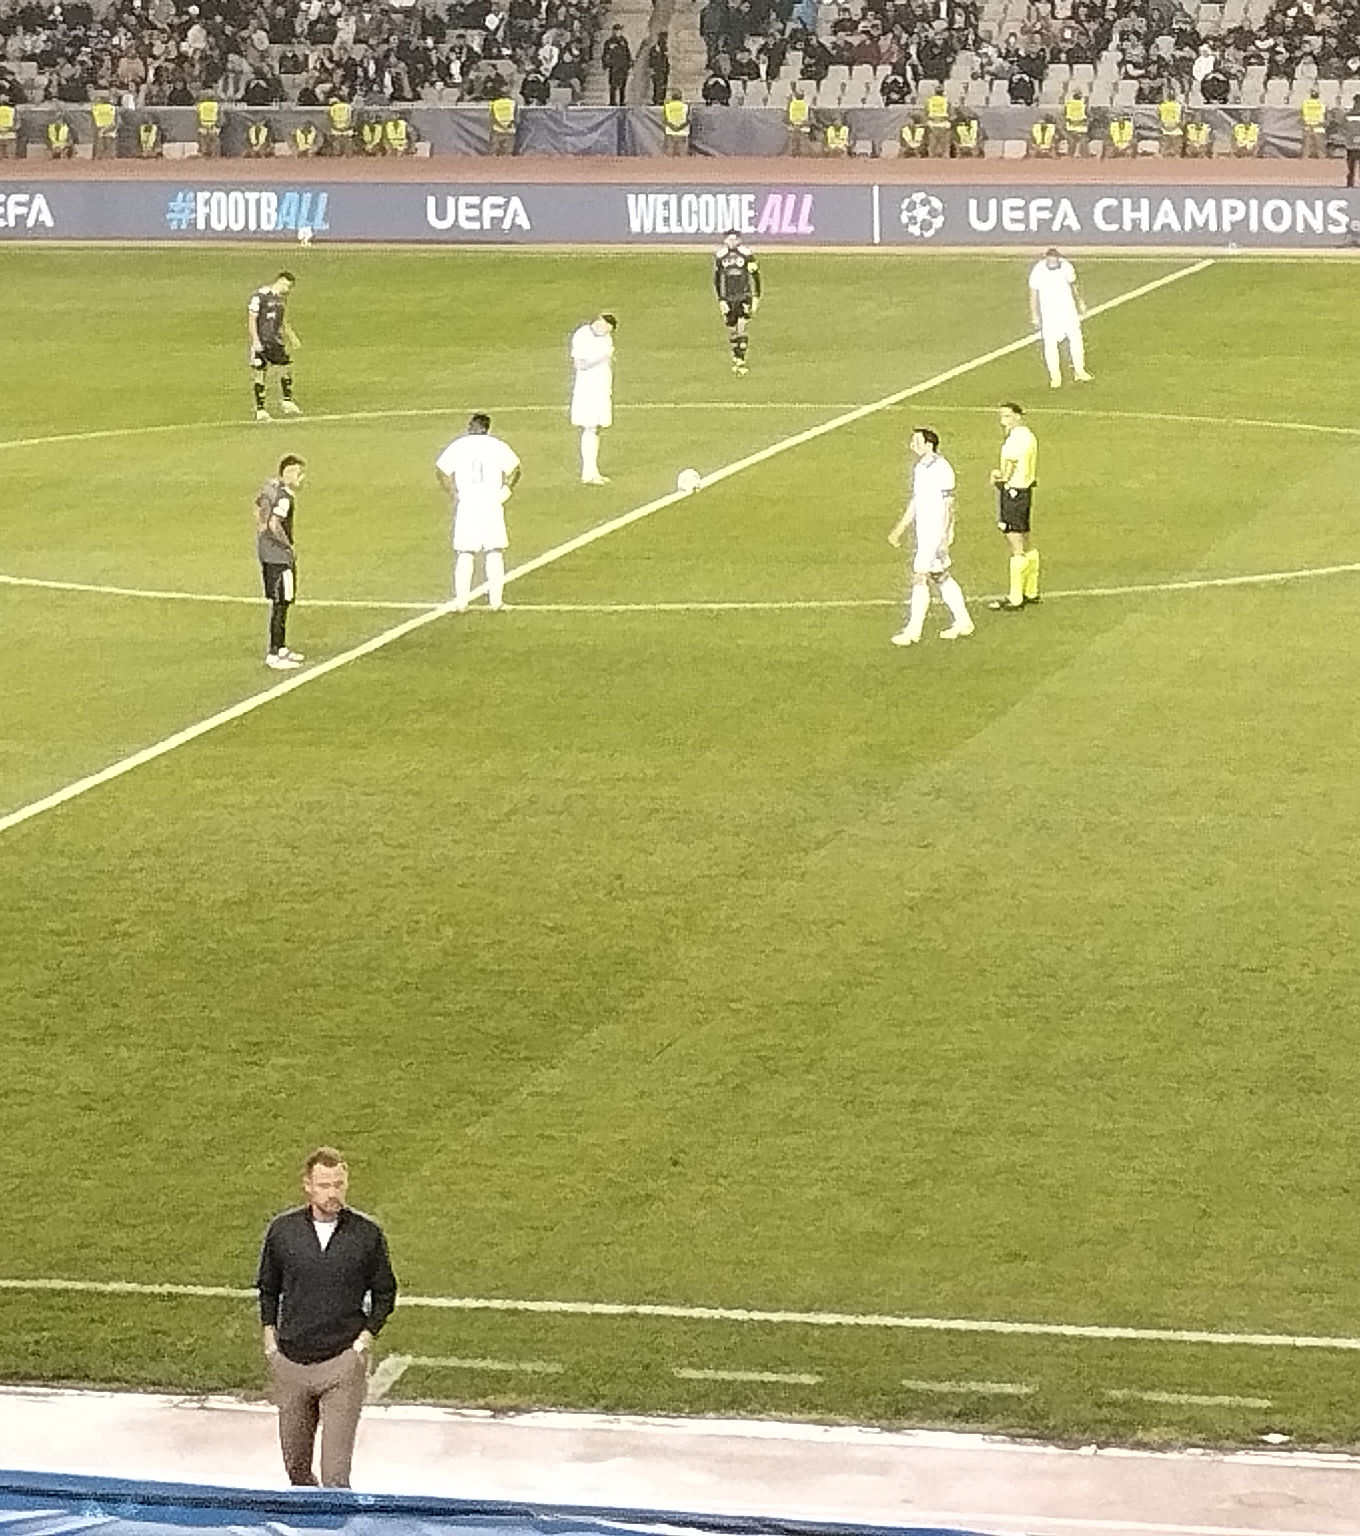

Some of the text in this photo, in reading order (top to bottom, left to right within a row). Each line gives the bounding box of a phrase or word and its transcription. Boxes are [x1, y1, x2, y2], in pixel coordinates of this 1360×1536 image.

[166, 192, 330, 230] #FOOTBALL
[426, 196, 531, 230] UEFA
[627, 194, 814, 233] WELCOME ALL
[968, 198, 1081, 232] UEFA
[1093, 198, 1349, 234] CHAMPIONS
